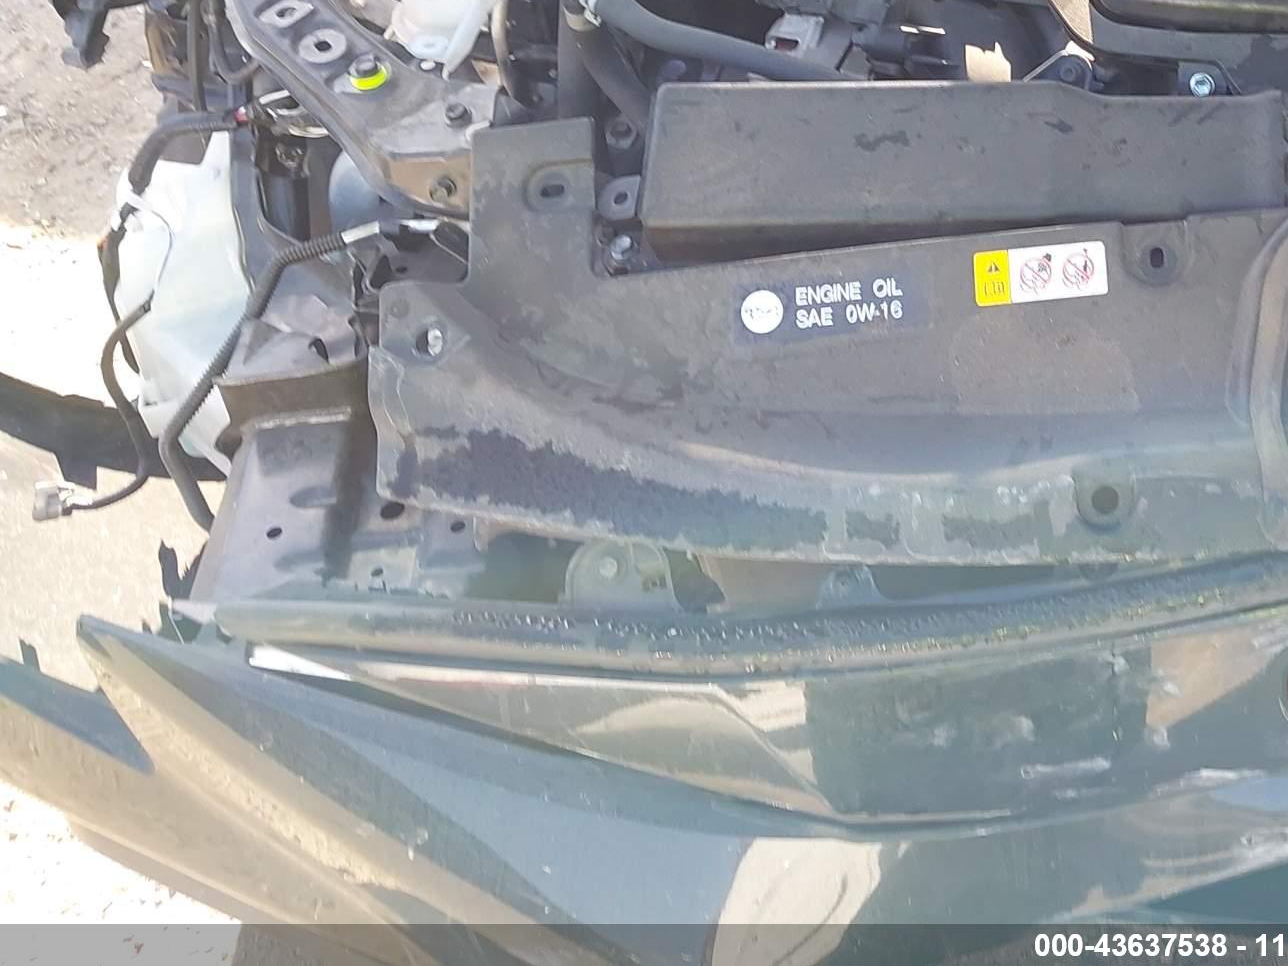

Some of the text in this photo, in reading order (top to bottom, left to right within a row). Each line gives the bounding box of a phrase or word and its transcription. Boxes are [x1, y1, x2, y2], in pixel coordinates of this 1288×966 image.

[795, 277, 904, 307] ENGINE OIL
[795, 306, 834, 330] SAE
[845, 300, 904, 325] 0W-16
